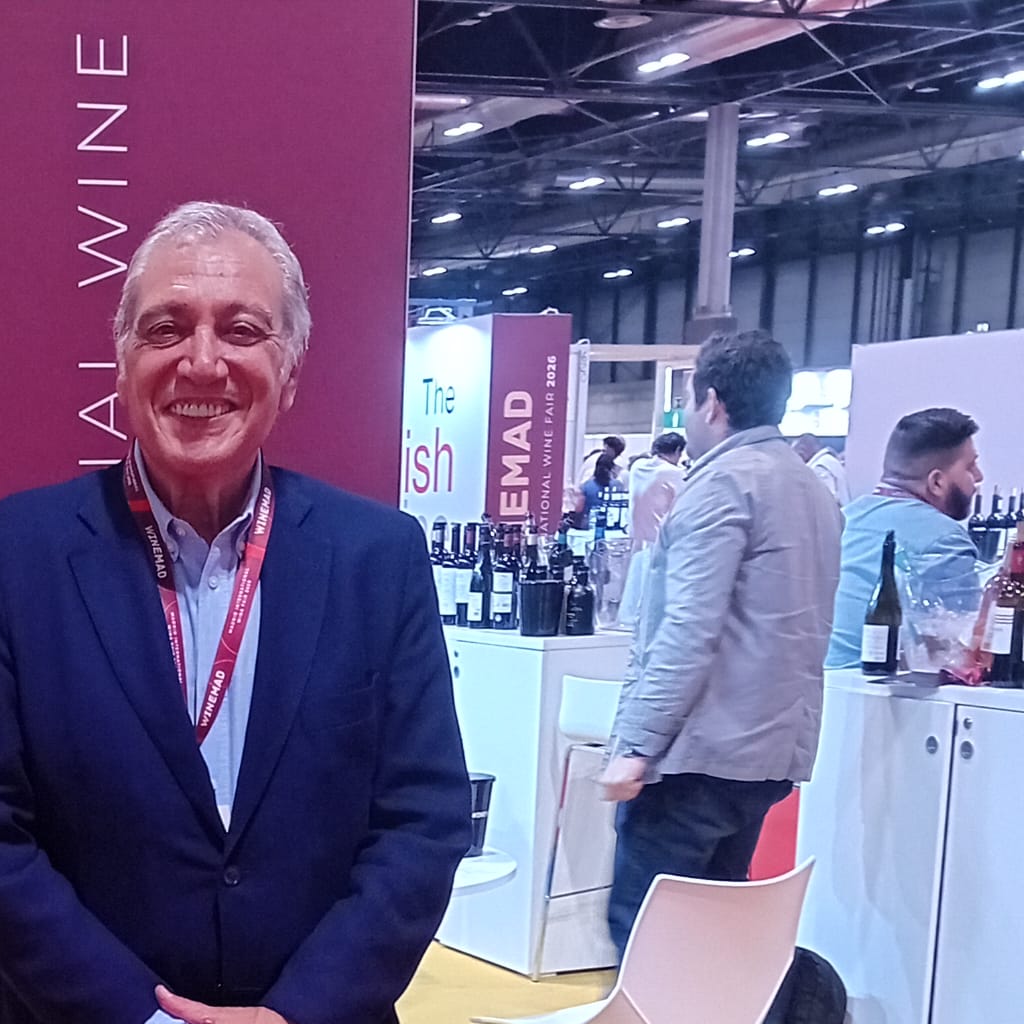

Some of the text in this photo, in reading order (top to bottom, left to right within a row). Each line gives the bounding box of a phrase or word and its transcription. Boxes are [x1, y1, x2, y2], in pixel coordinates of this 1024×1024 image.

[76, 34, 128, 289] WINE
[422, 378, 456, 415] The
[404, 427, 454, 494] ish
[499, 390, 533, 526] EMAD
[539, 355, 558, 532] ATIONAL WINE FAIR 2026
[253, 486, 273, 536] WINEMAD
[144, 525, 168, 580] WINEMAD
[199, 669, 226, 728] WINEMAD
